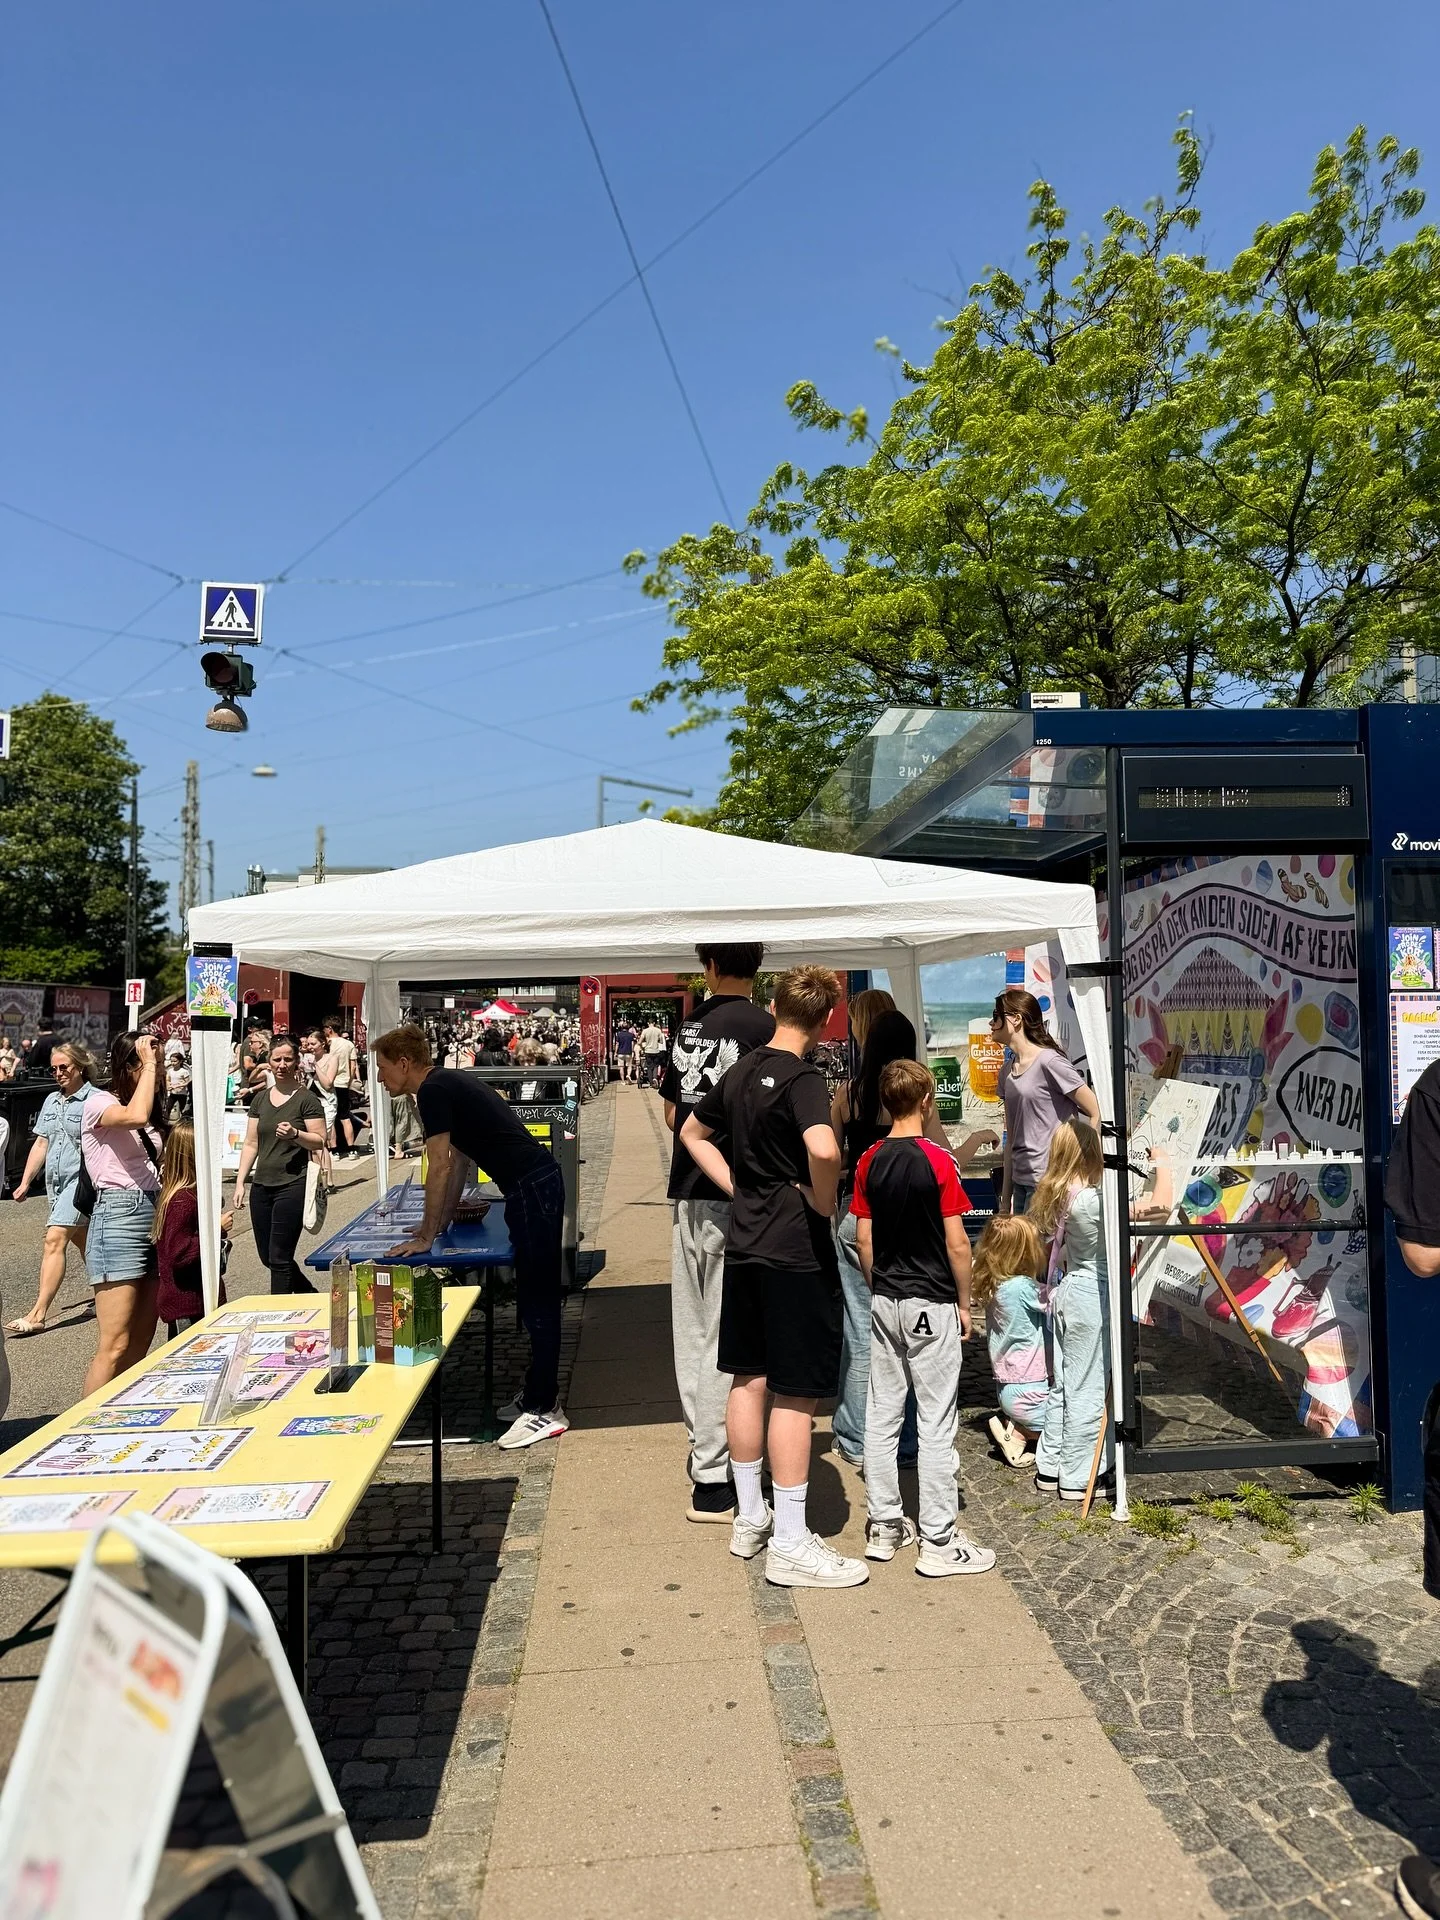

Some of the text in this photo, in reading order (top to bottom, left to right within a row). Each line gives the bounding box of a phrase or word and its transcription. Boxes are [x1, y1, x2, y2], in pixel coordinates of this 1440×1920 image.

[1138, 941, 1152, 976] OS
[1151, 921, 1168, 963] PÅ
[1166, 904, 1189, 948] DEN
[1190, 895, 1236, 931] ANDEN
[1238, 899, 1281, 951] SIDEN
[1281, 921, 1305, 960] AF
[1308, 927, 1357, 970] VEJEN
[971, 1044, 1005, 1060] Carlsber
[961, 1208, 994, 1216] Decaux
[913, 1311, 933, 1335] A
